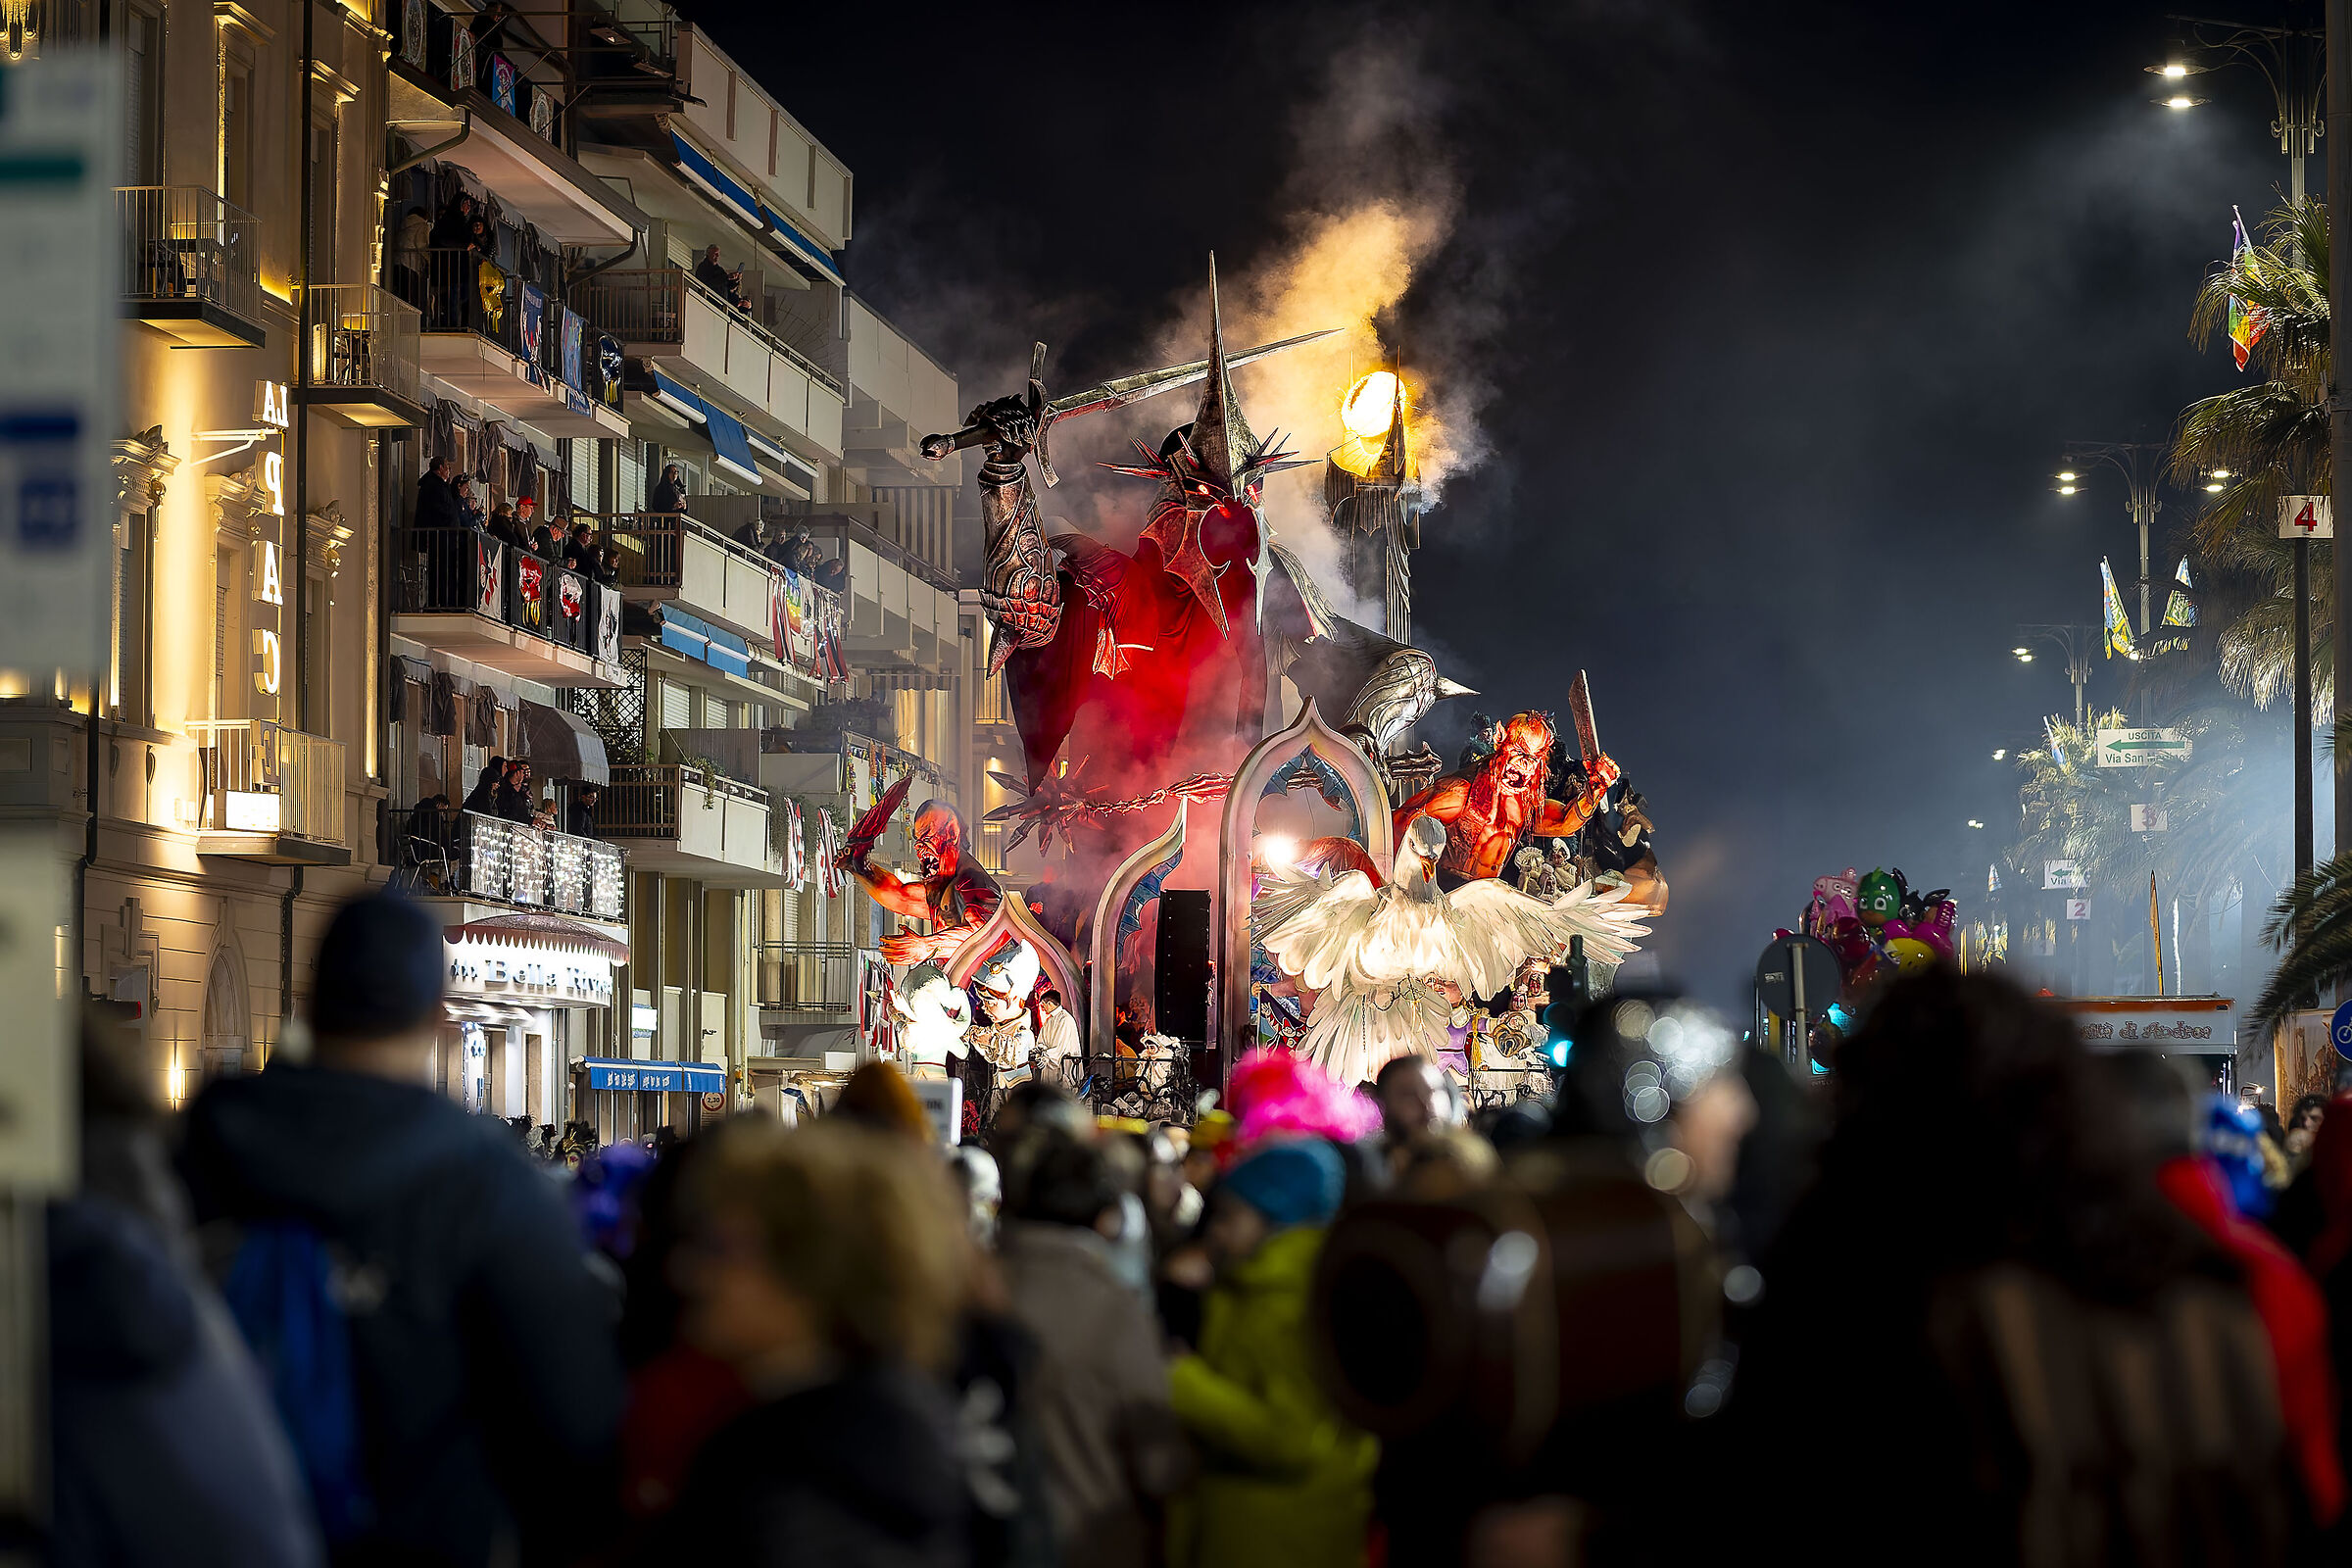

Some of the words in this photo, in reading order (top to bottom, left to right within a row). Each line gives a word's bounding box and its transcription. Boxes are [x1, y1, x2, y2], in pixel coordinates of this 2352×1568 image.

[2294, 501, 2318, 532] 4
[2128, 731, 2162, 741] USCITA
[2105, 753, 2122, 763] Via
[2124, 753, 2144, 763] San
[2074, 902, 2086, 917] 2
[484, 959, 558, 987] Bella
